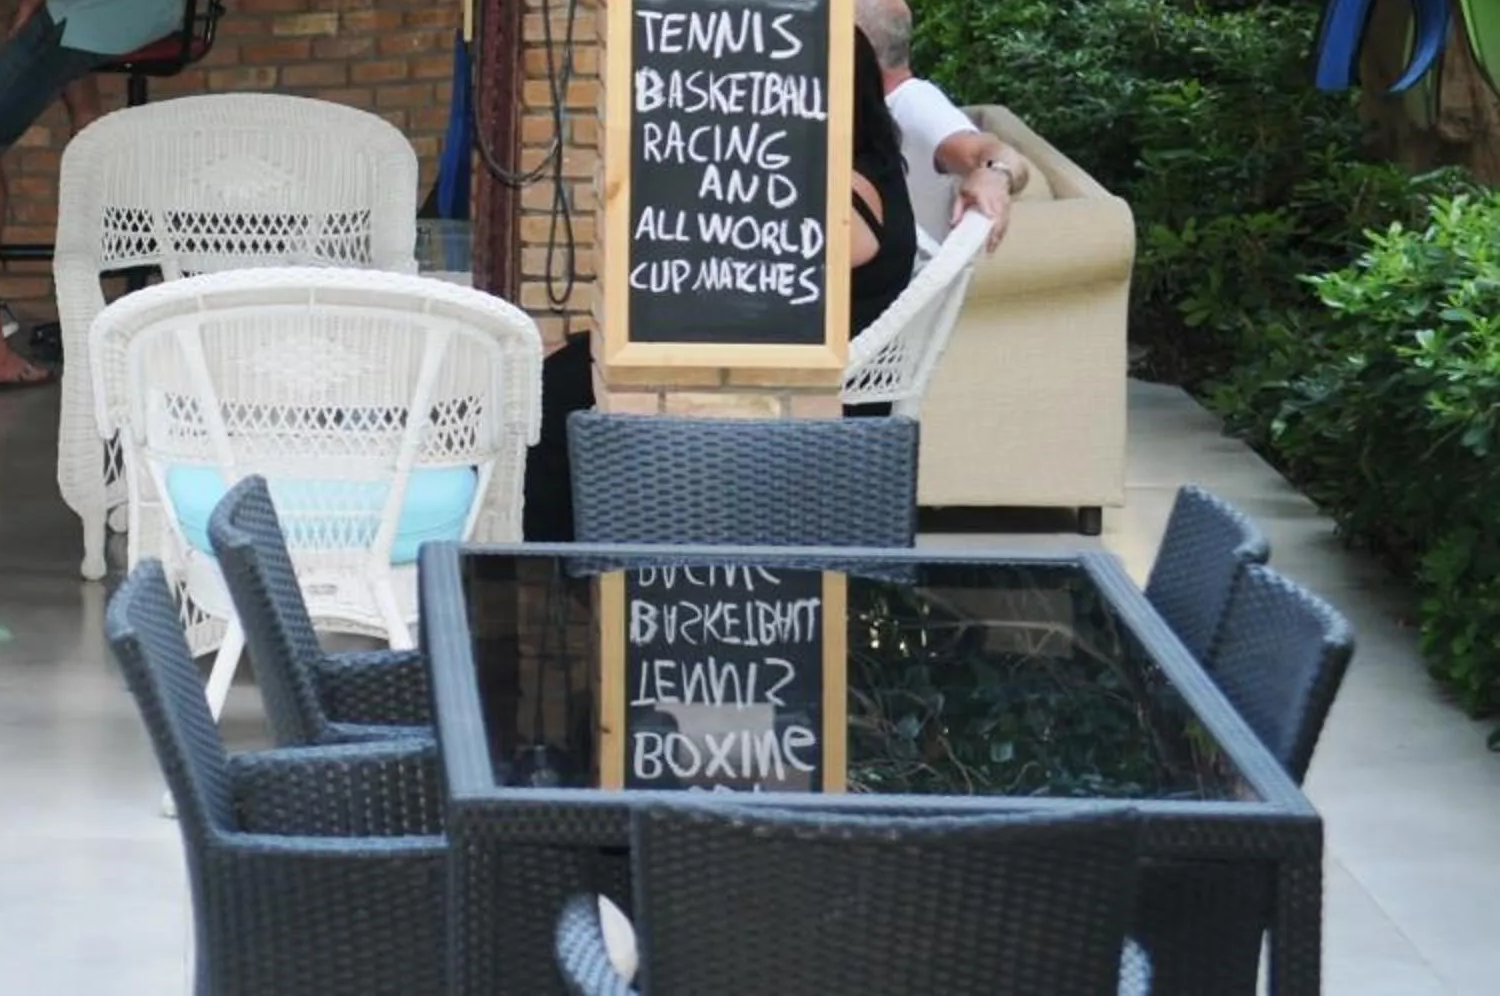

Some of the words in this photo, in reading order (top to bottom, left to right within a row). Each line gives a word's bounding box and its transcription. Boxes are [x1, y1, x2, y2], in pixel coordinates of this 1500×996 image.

[635, 8, 803, 60] TENNIS
[634, 66, 828, 121] BASKETBALL
[643, 121, 791, 170] RACING
[698, 163, 798, 209] AND
[634, 205, 690, 241] ALL
[697, 212, 825, 260] WORLD
[629, 258, 693, 294] CUP
[691, 256, 820, 305] MATCHES
